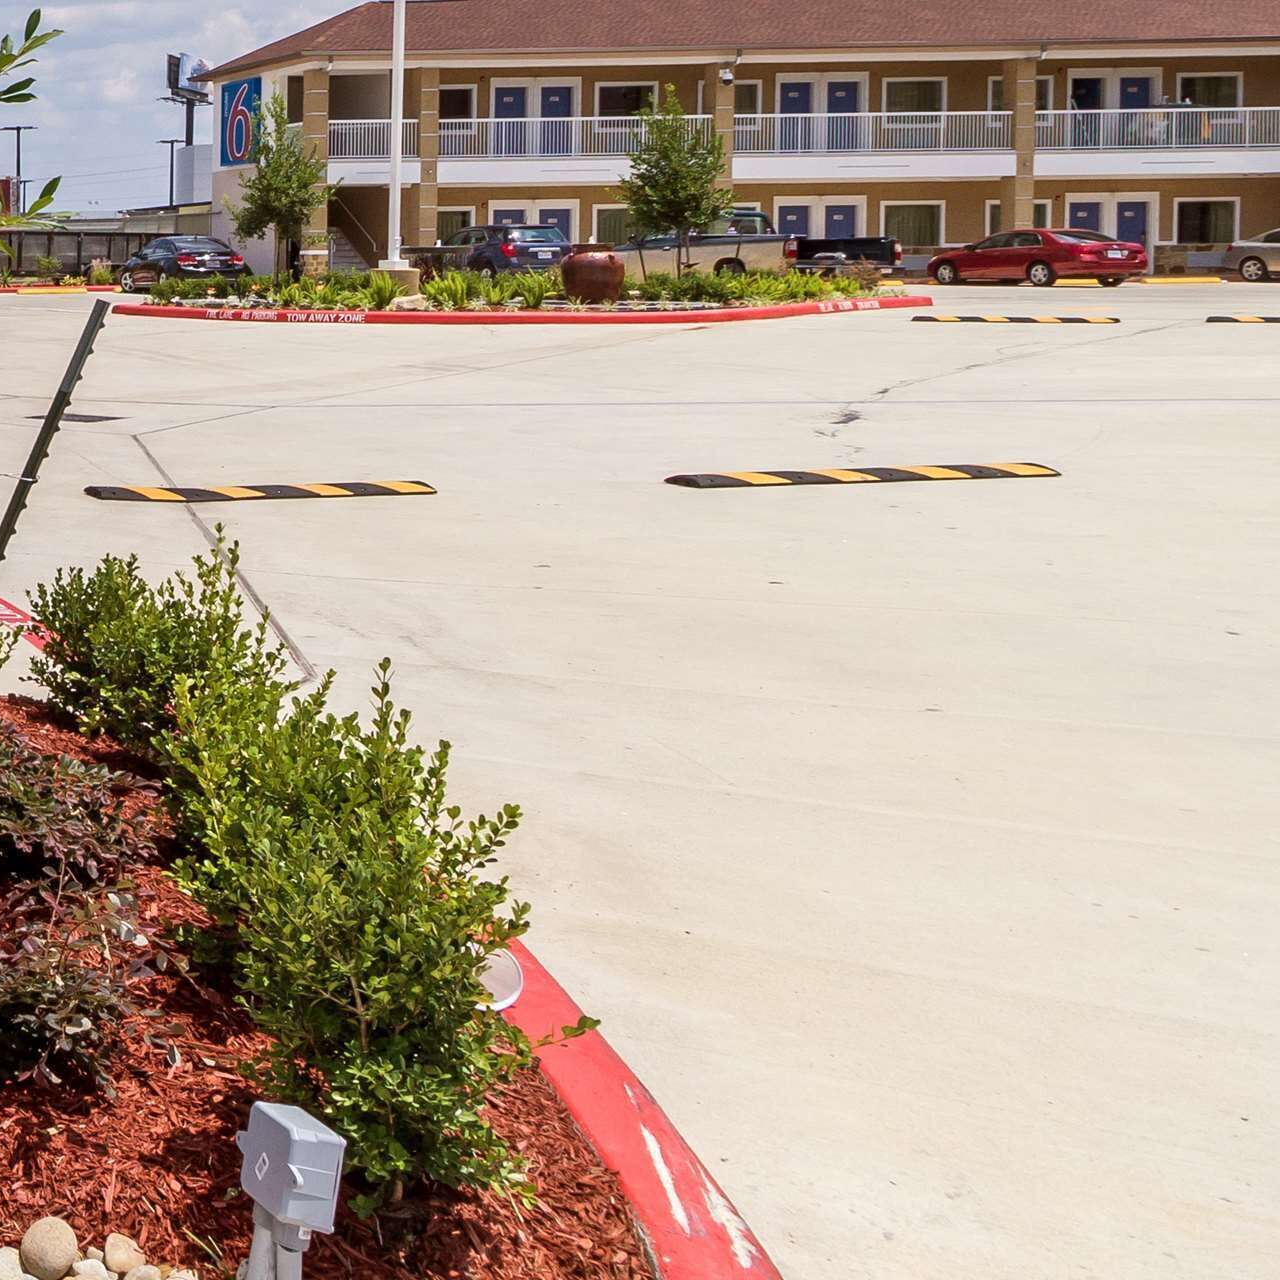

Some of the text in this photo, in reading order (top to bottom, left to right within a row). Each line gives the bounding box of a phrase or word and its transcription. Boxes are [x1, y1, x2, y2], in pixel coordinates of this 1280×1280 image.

[226, 83, 252, 161] 6
[286, 313, 307, 322] TOW
[308, 313, 336, 323] AWAY
[338, 313, 366, 323] ZONE
